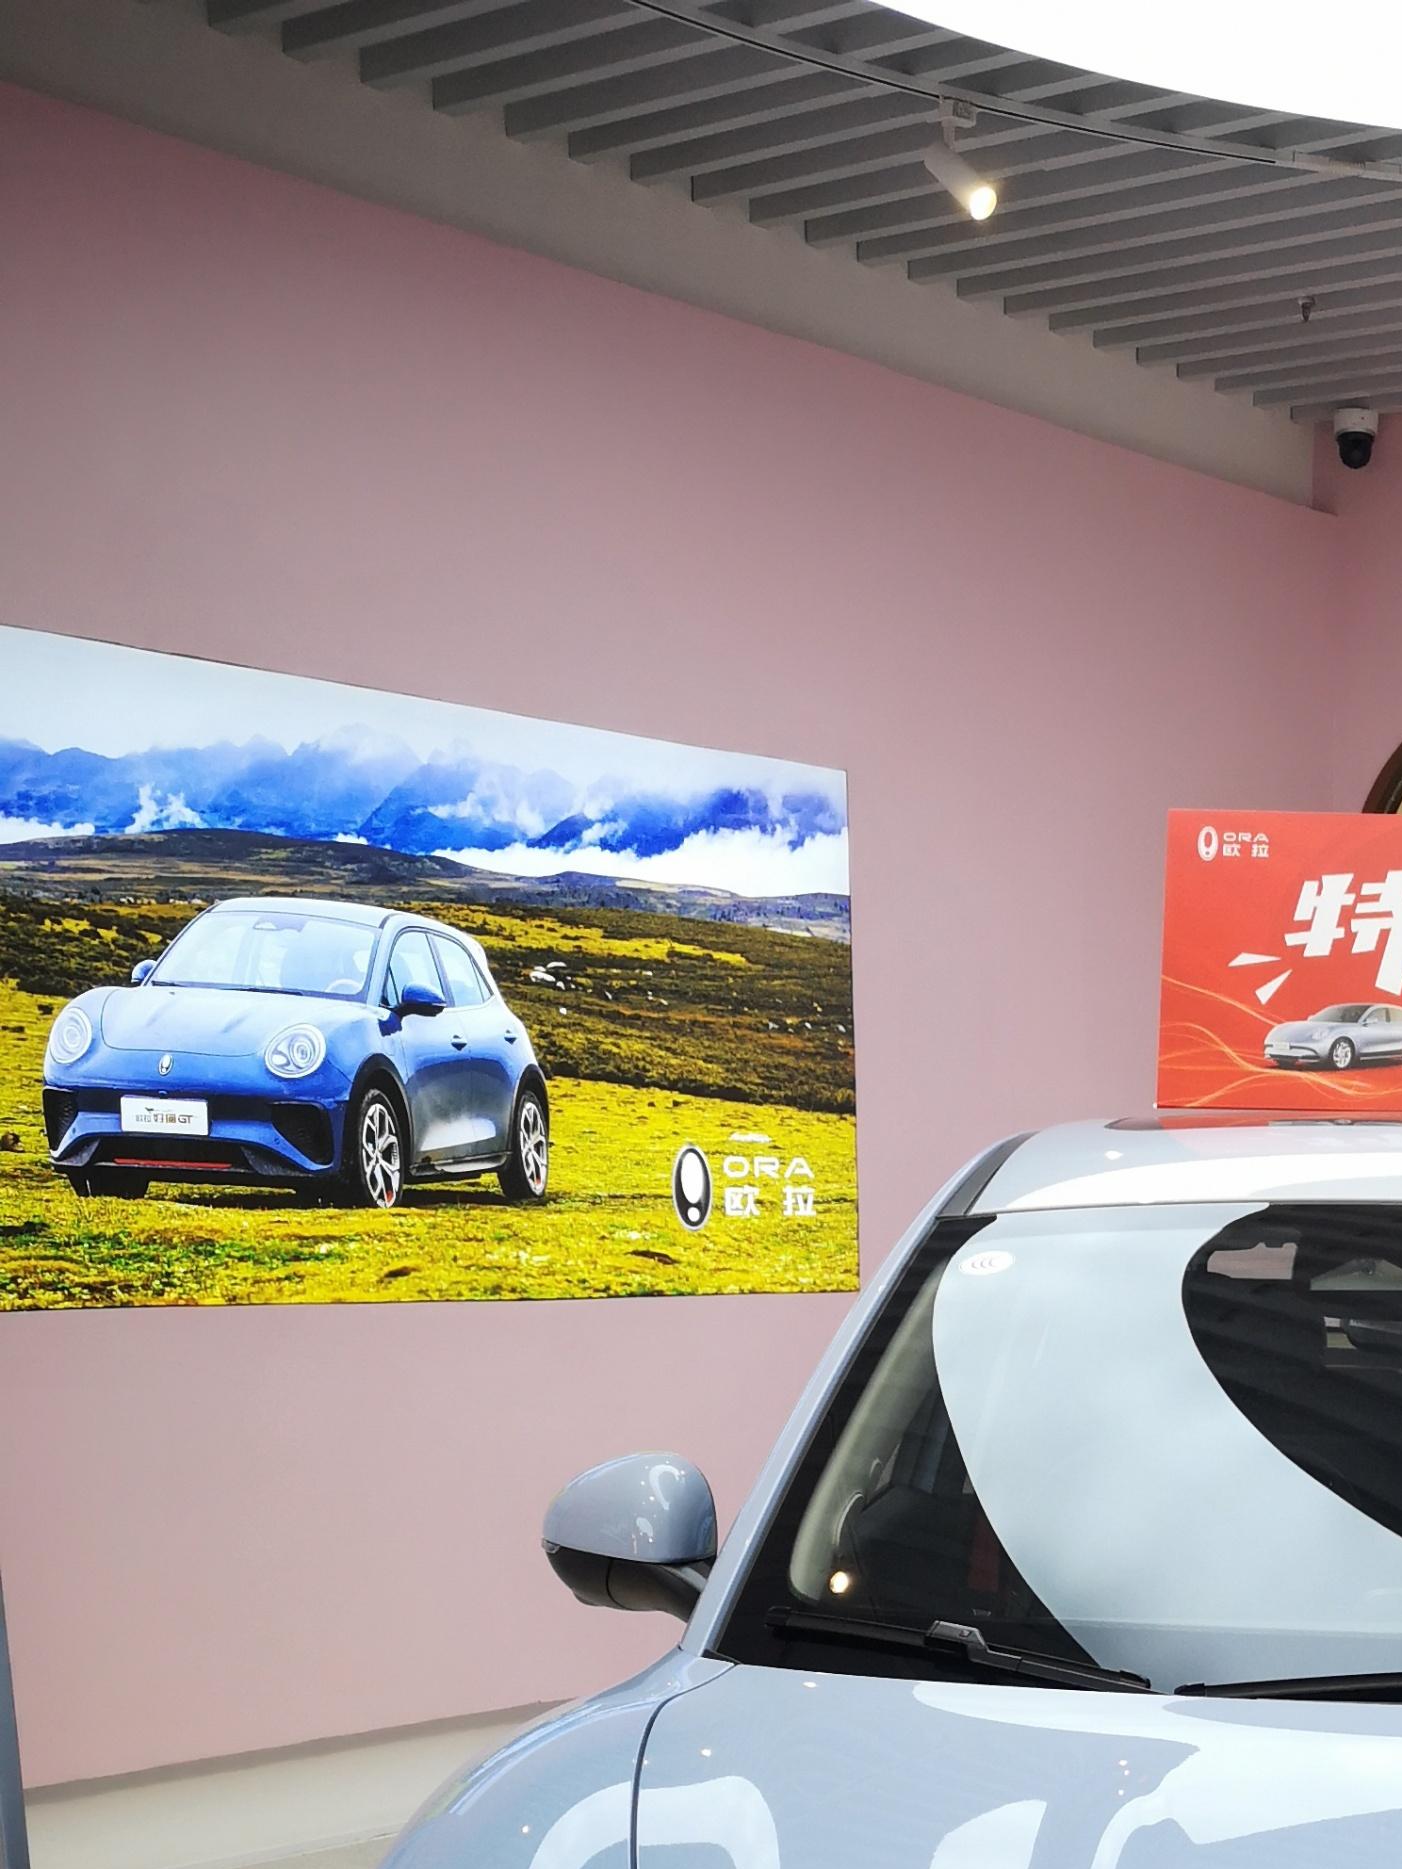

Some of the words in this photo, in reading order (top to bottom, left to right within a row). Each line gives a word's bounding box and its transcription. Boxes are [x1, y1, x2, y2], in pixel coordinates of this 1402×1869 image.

[1223, 831, 1270, 843] ORA
[1222, 843, 1270, 858] 欧拉
[723, 1155, 815, 1179] ORA
[724, 1185, 817, 1217] 欧拉
